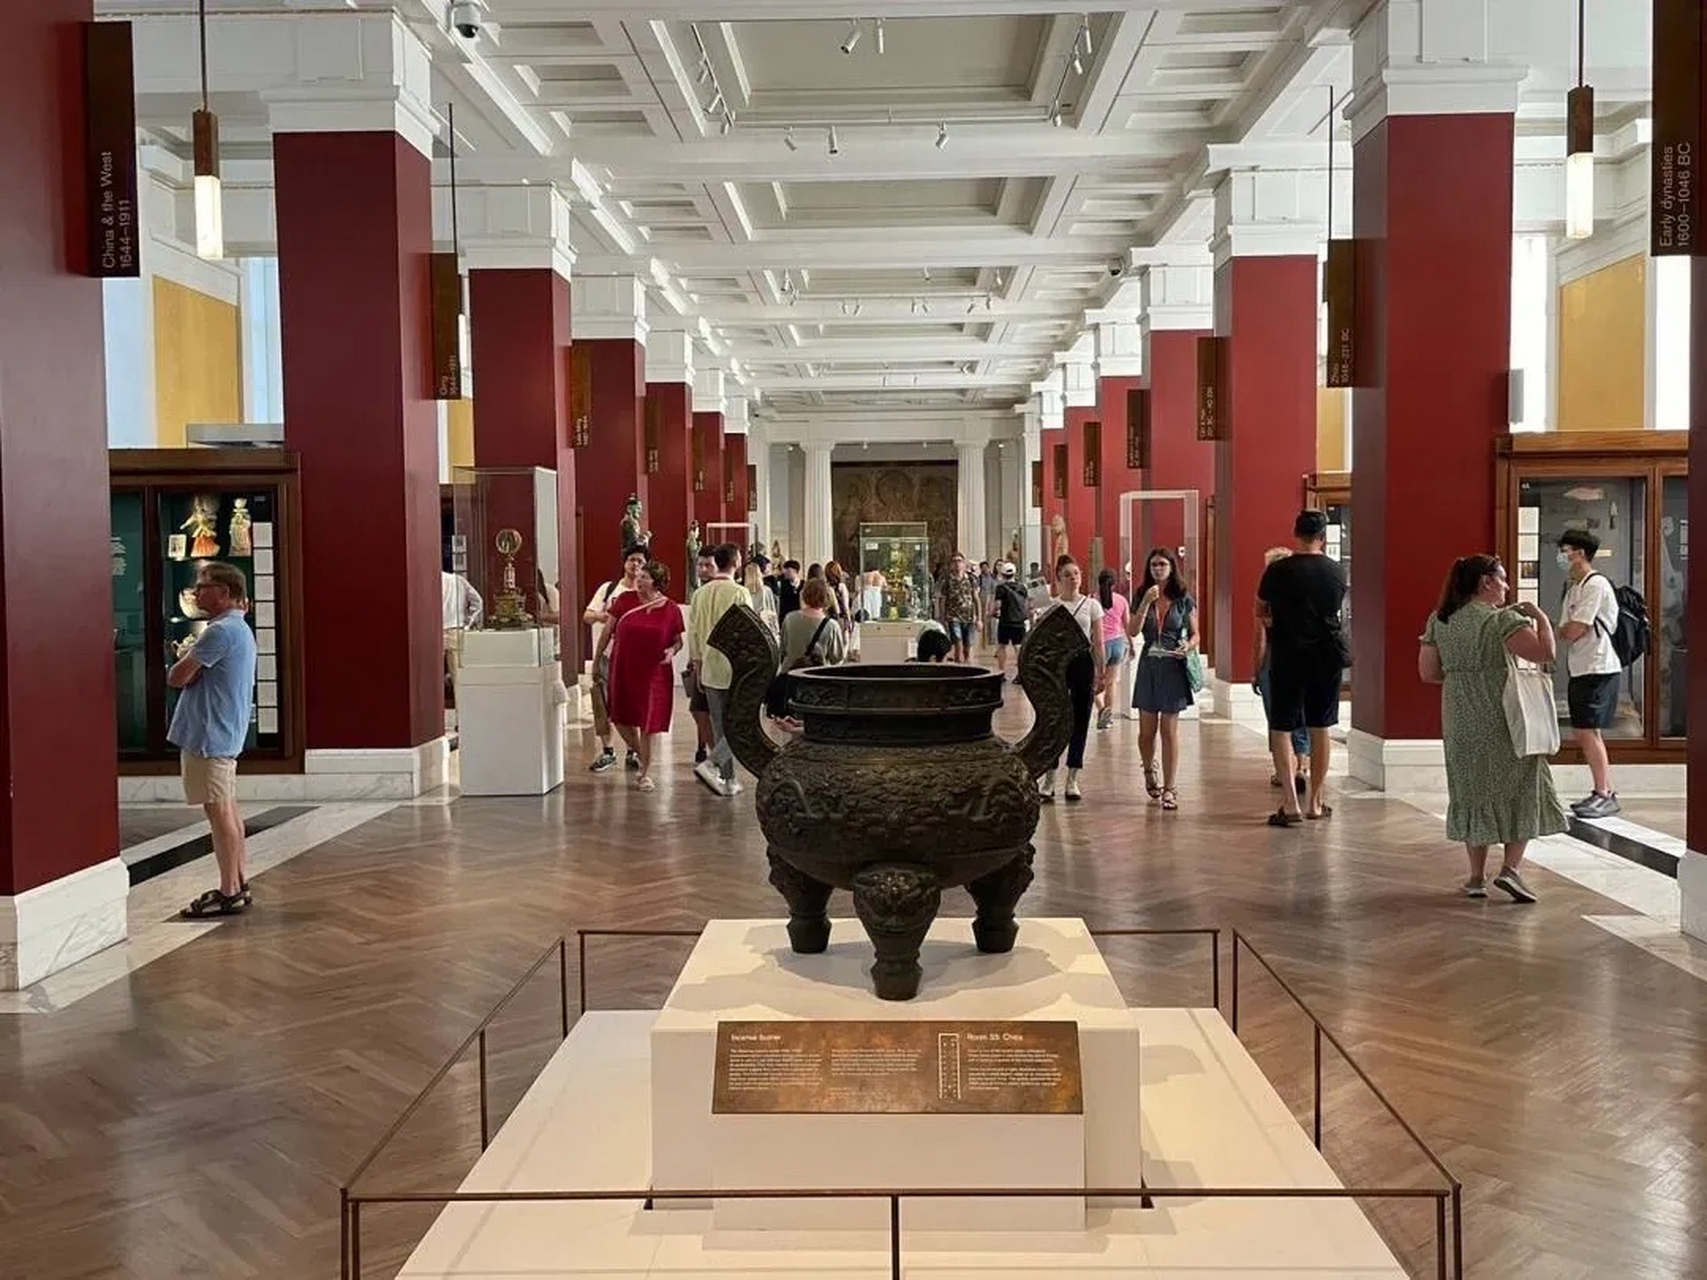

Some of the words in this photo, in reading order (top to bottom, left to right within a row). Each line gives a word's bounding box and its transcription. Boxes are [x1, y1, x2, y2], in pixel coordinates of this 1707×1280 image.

[100, 151, 113, 187] West
[1677, 142, 1691, 165] BC
[1659, 146, 1676, 210] dynasties
[101, 190, 114, 212] the
[101, 215, 114, 226] &
[1659, 214, 1675, 247] Early
[101, 229, 115, 269] China
